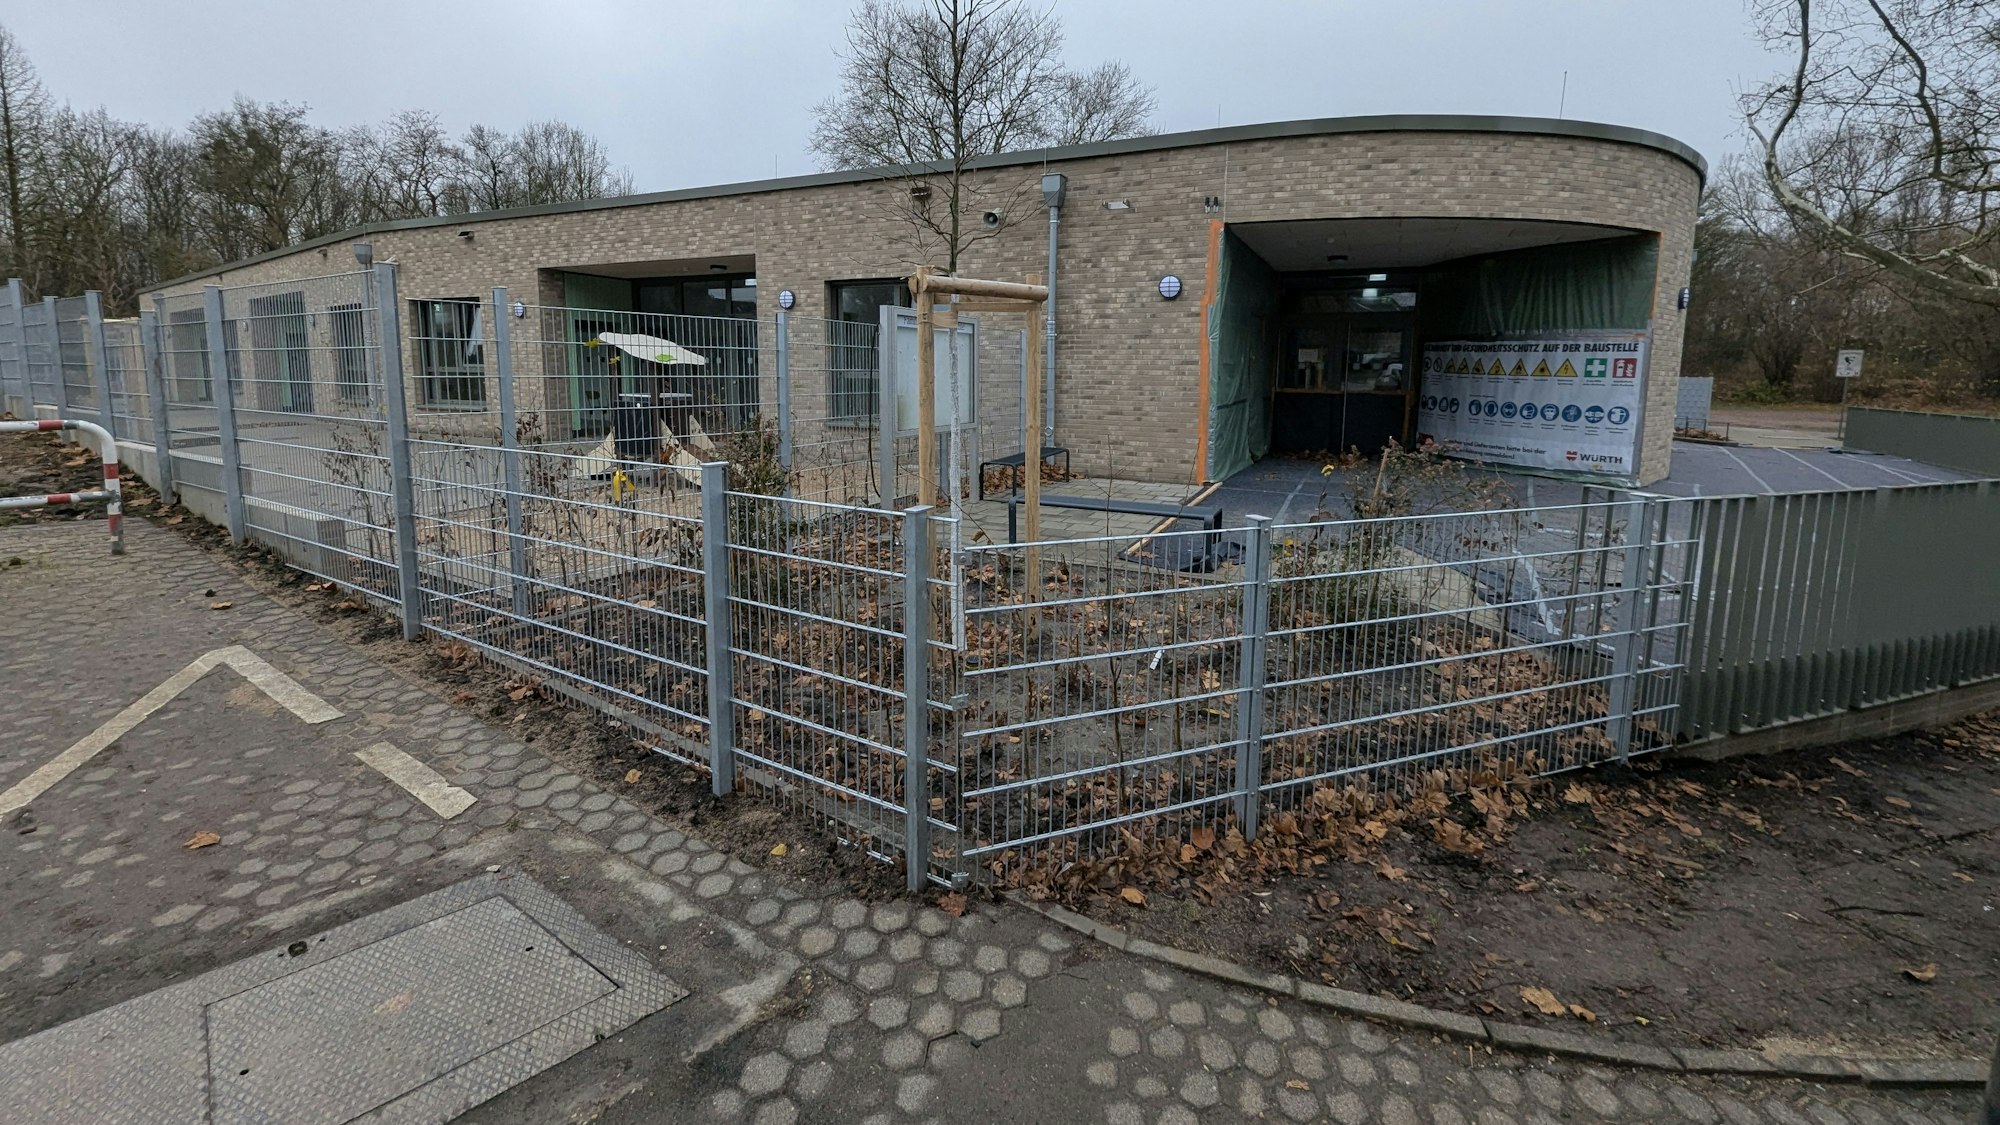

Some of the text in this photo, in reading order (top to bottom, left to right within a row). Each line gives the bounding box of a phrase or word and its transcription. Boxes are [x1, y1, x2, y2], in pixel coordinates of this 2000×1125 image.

[1542, 343, 1560, 353] AUF
[1562, 343, 1581, 353] DER
[1583, 342, 1640, 353] BAUSTELLE
[1534, 447, 1547, 455] der
[1580, 453, 1623, 464] WÜRTH
